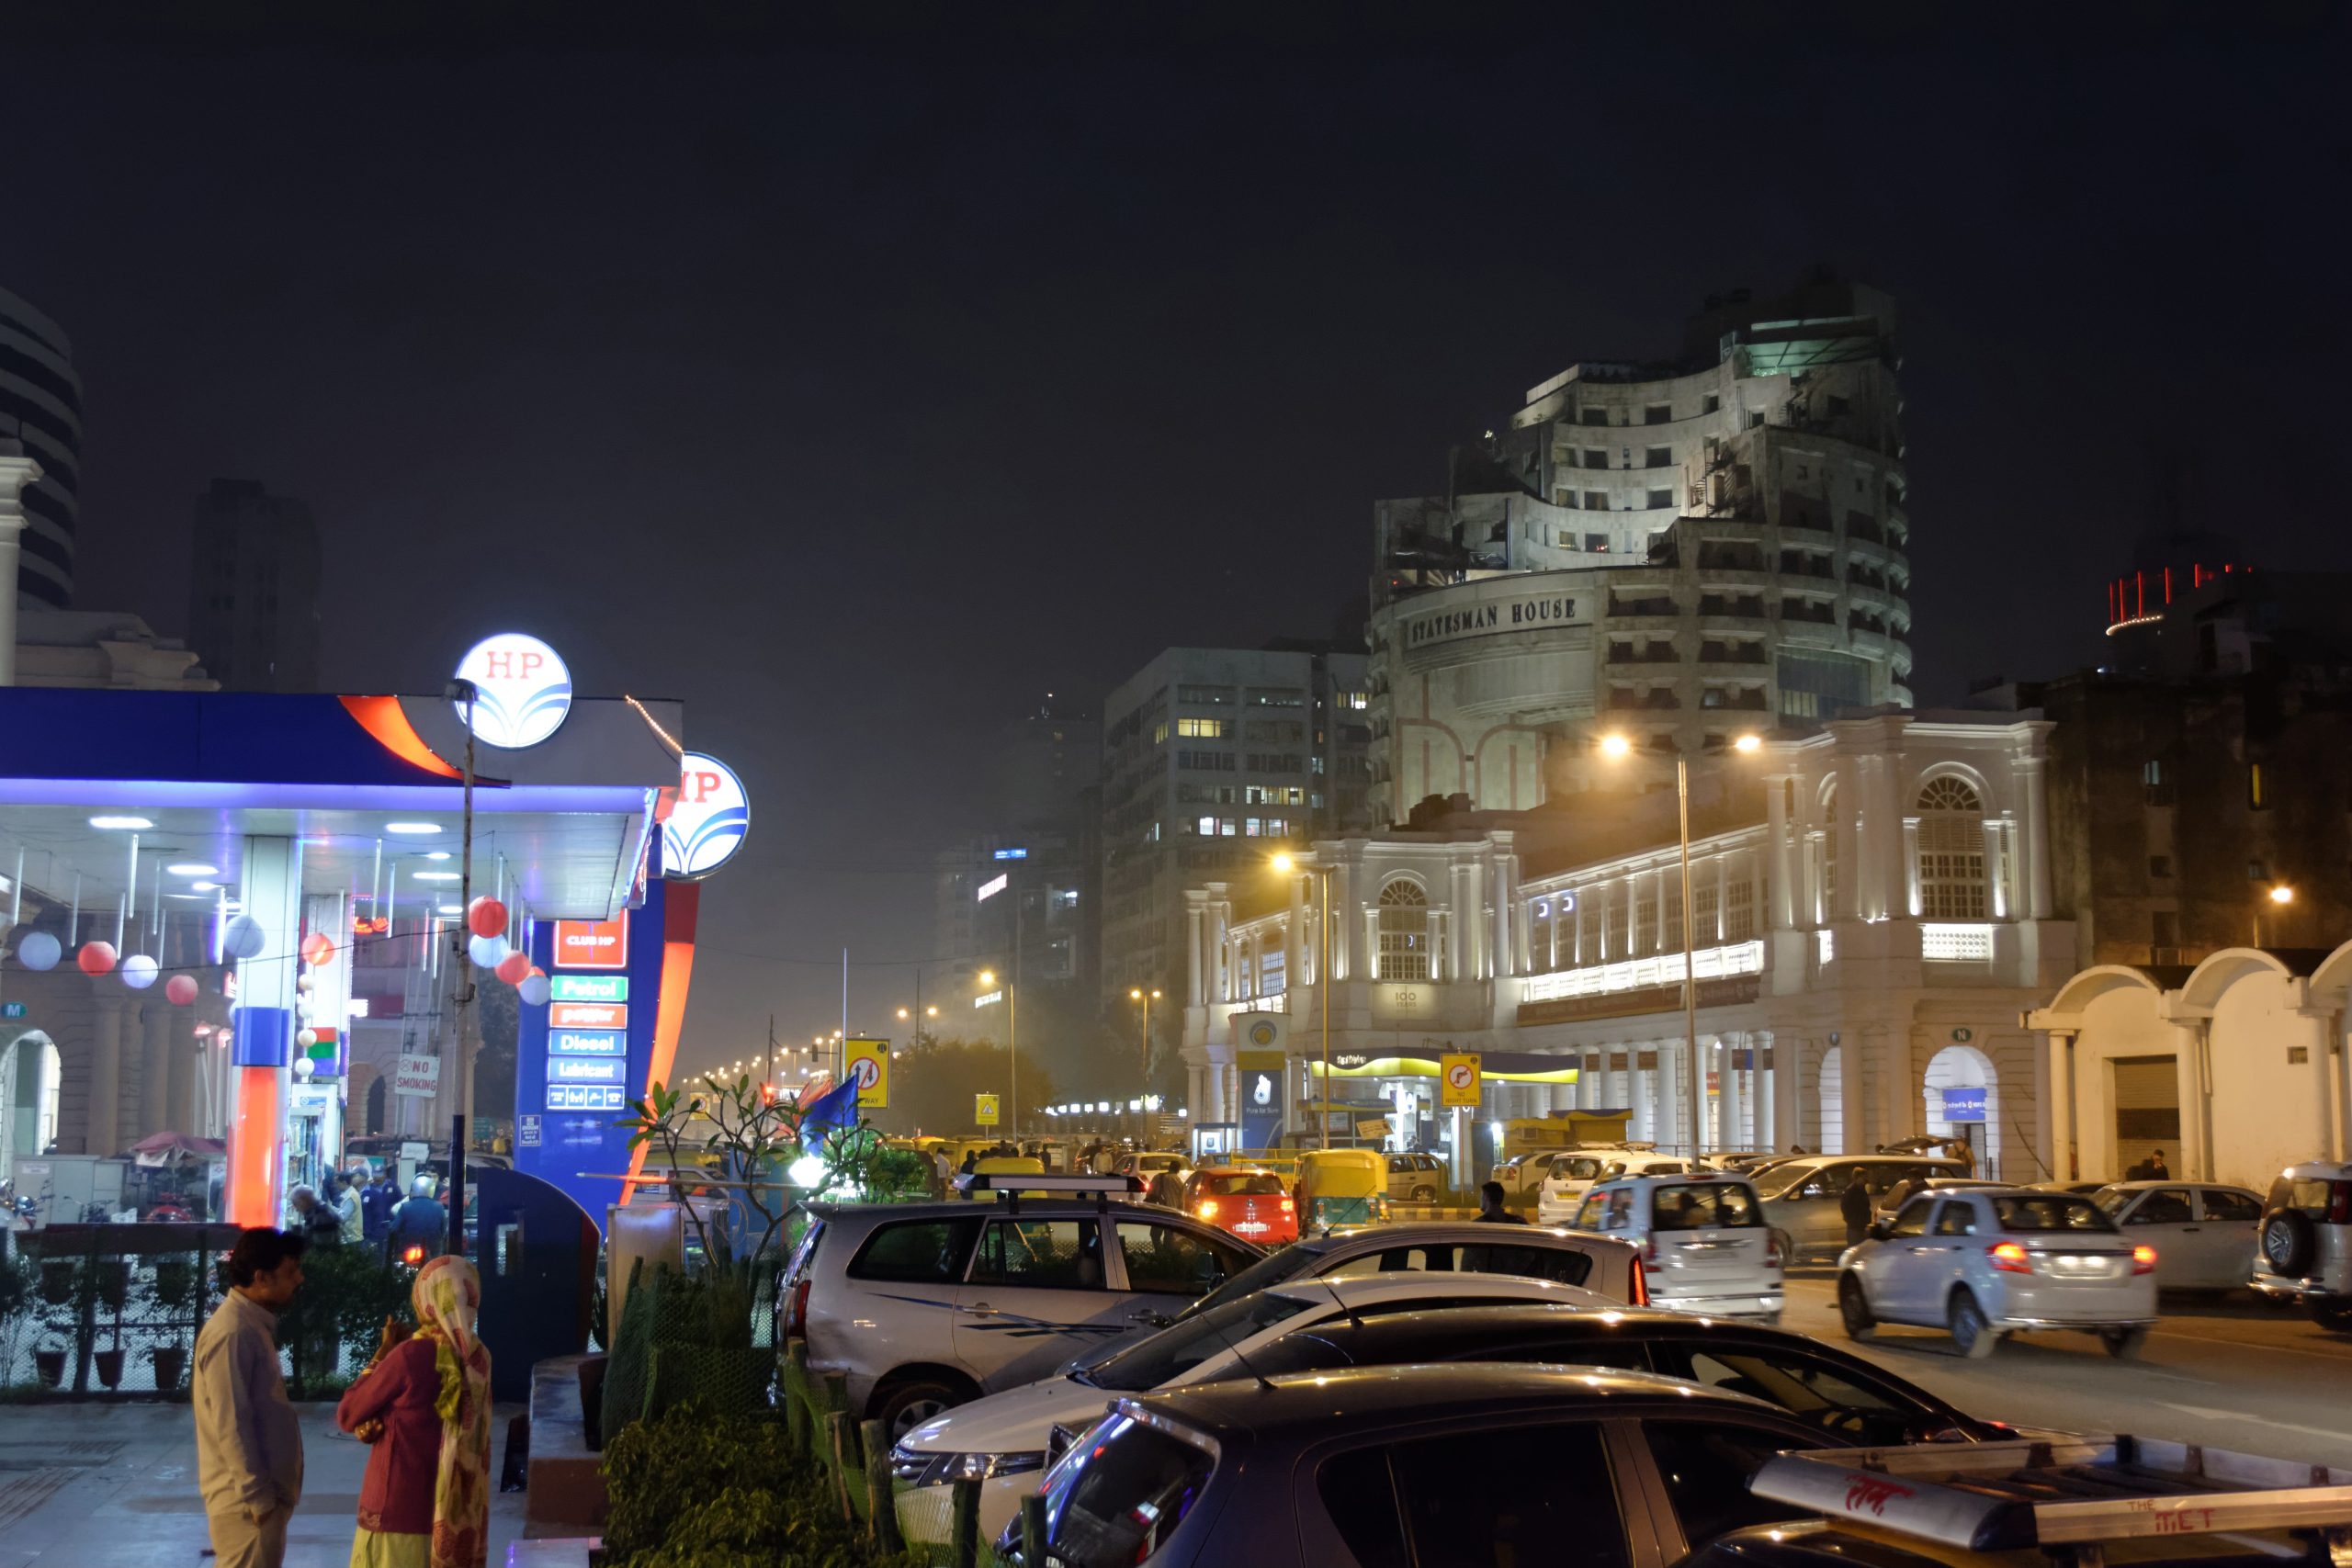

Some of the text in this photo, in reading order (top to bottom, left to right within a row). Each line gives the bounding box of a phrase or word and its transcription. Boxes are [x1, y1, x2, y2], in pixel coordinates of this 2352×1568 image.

[1411, 598, 1576, 643] STATESMAN HOUSE
[486, 650, 544, 680] HP
[565, 935, 616, 946] CLUB HP
[561, 980, 616, 998] Petrol
[7, 1004, 20, 1017] M
[1957, 1029, 1967, 1041] N
[560, 1034, 614, 1051] Diesel
[412, 1061, 429, 1074] NO
[559, 1062, 614, 1078] Lubricant
[397, 1077, 437, 1091] SMOKING
[2126, 1498, 2155, 1512] THE
